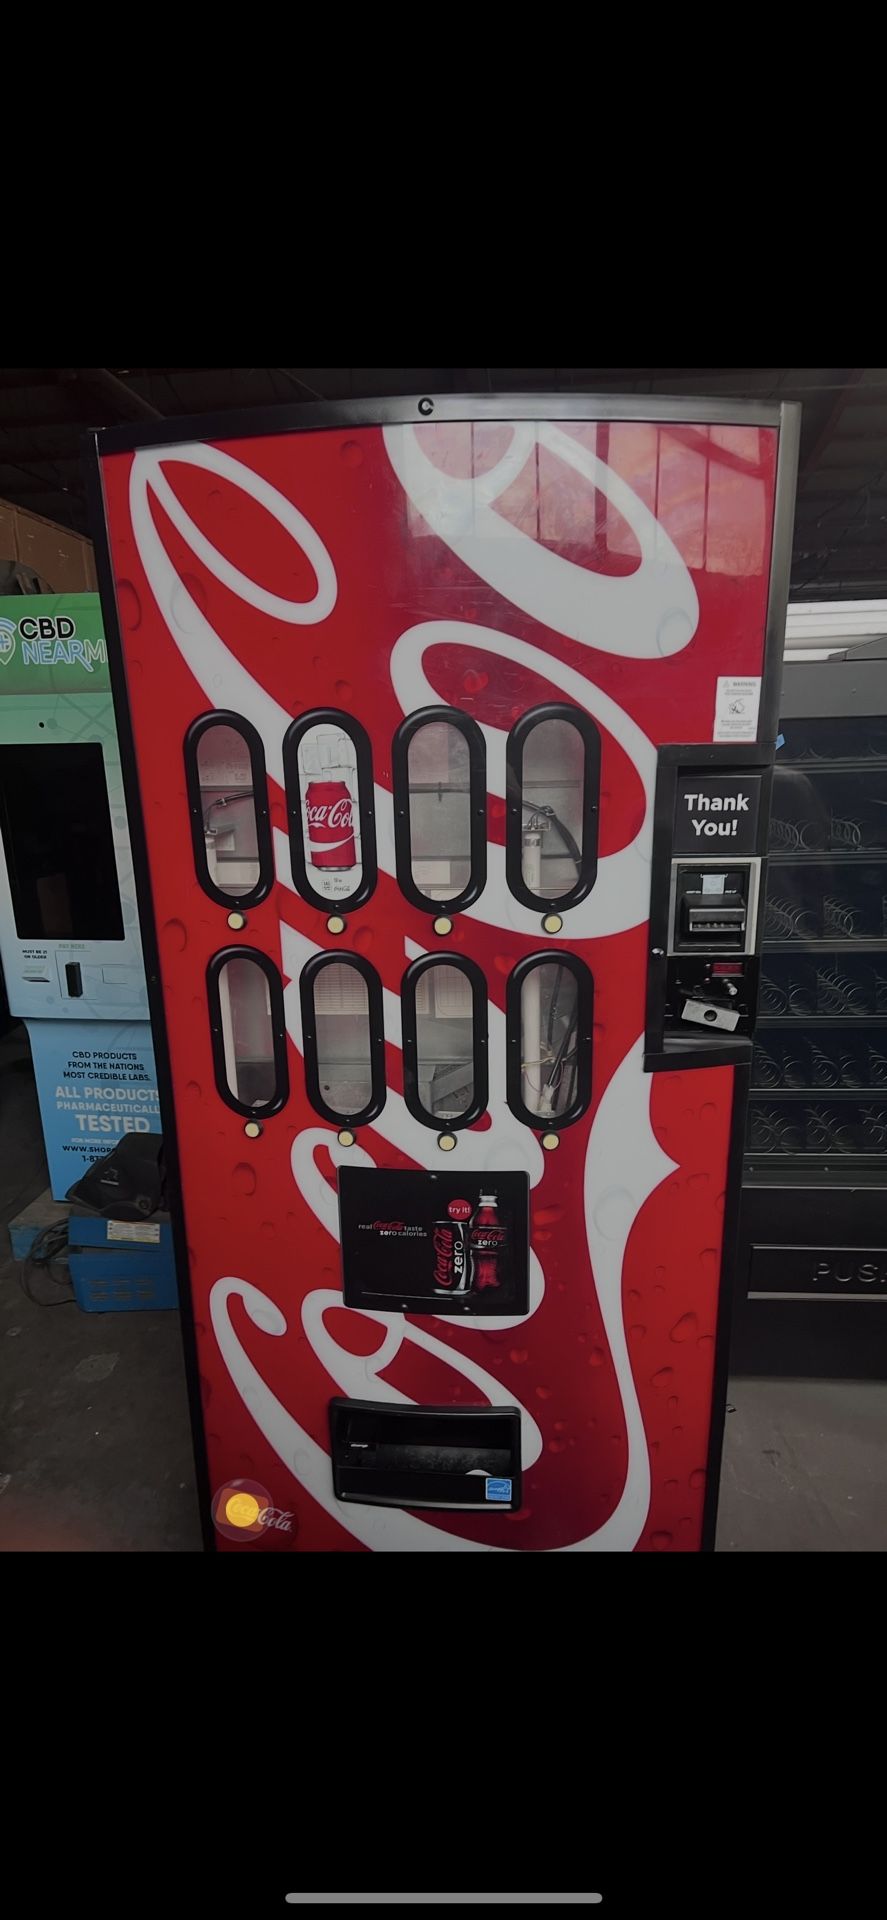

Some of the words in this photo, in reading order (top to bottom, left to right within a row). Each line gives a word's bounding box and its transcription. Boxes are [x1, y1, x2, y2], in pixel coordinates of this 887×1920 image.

[19, 617, 75, 640] CBD
[22, 639, 108, 672] NEARM
[684, 793, 750, 811] Thank
[691, 819, 738, 836] You!
[72, 1051, 90, 1059] CBD
[93, 1052, 137, 1060] PRODUCTS
[68, 1061, 91, 1069] FROM
[93, 1062, 107, 1070] THE
[110, 1063, 145, 1071] NATIONS
[63, 1071, 86, 1079] MOST
[88, 1072, 128, 1081] CREDIBLE
[55, 1086, 81, 1099] ALL
[75, 1114, 150, 1133] TESTED
[448, 1206, 461, 1214] try
[454, 1240, 463, 1274] zero
